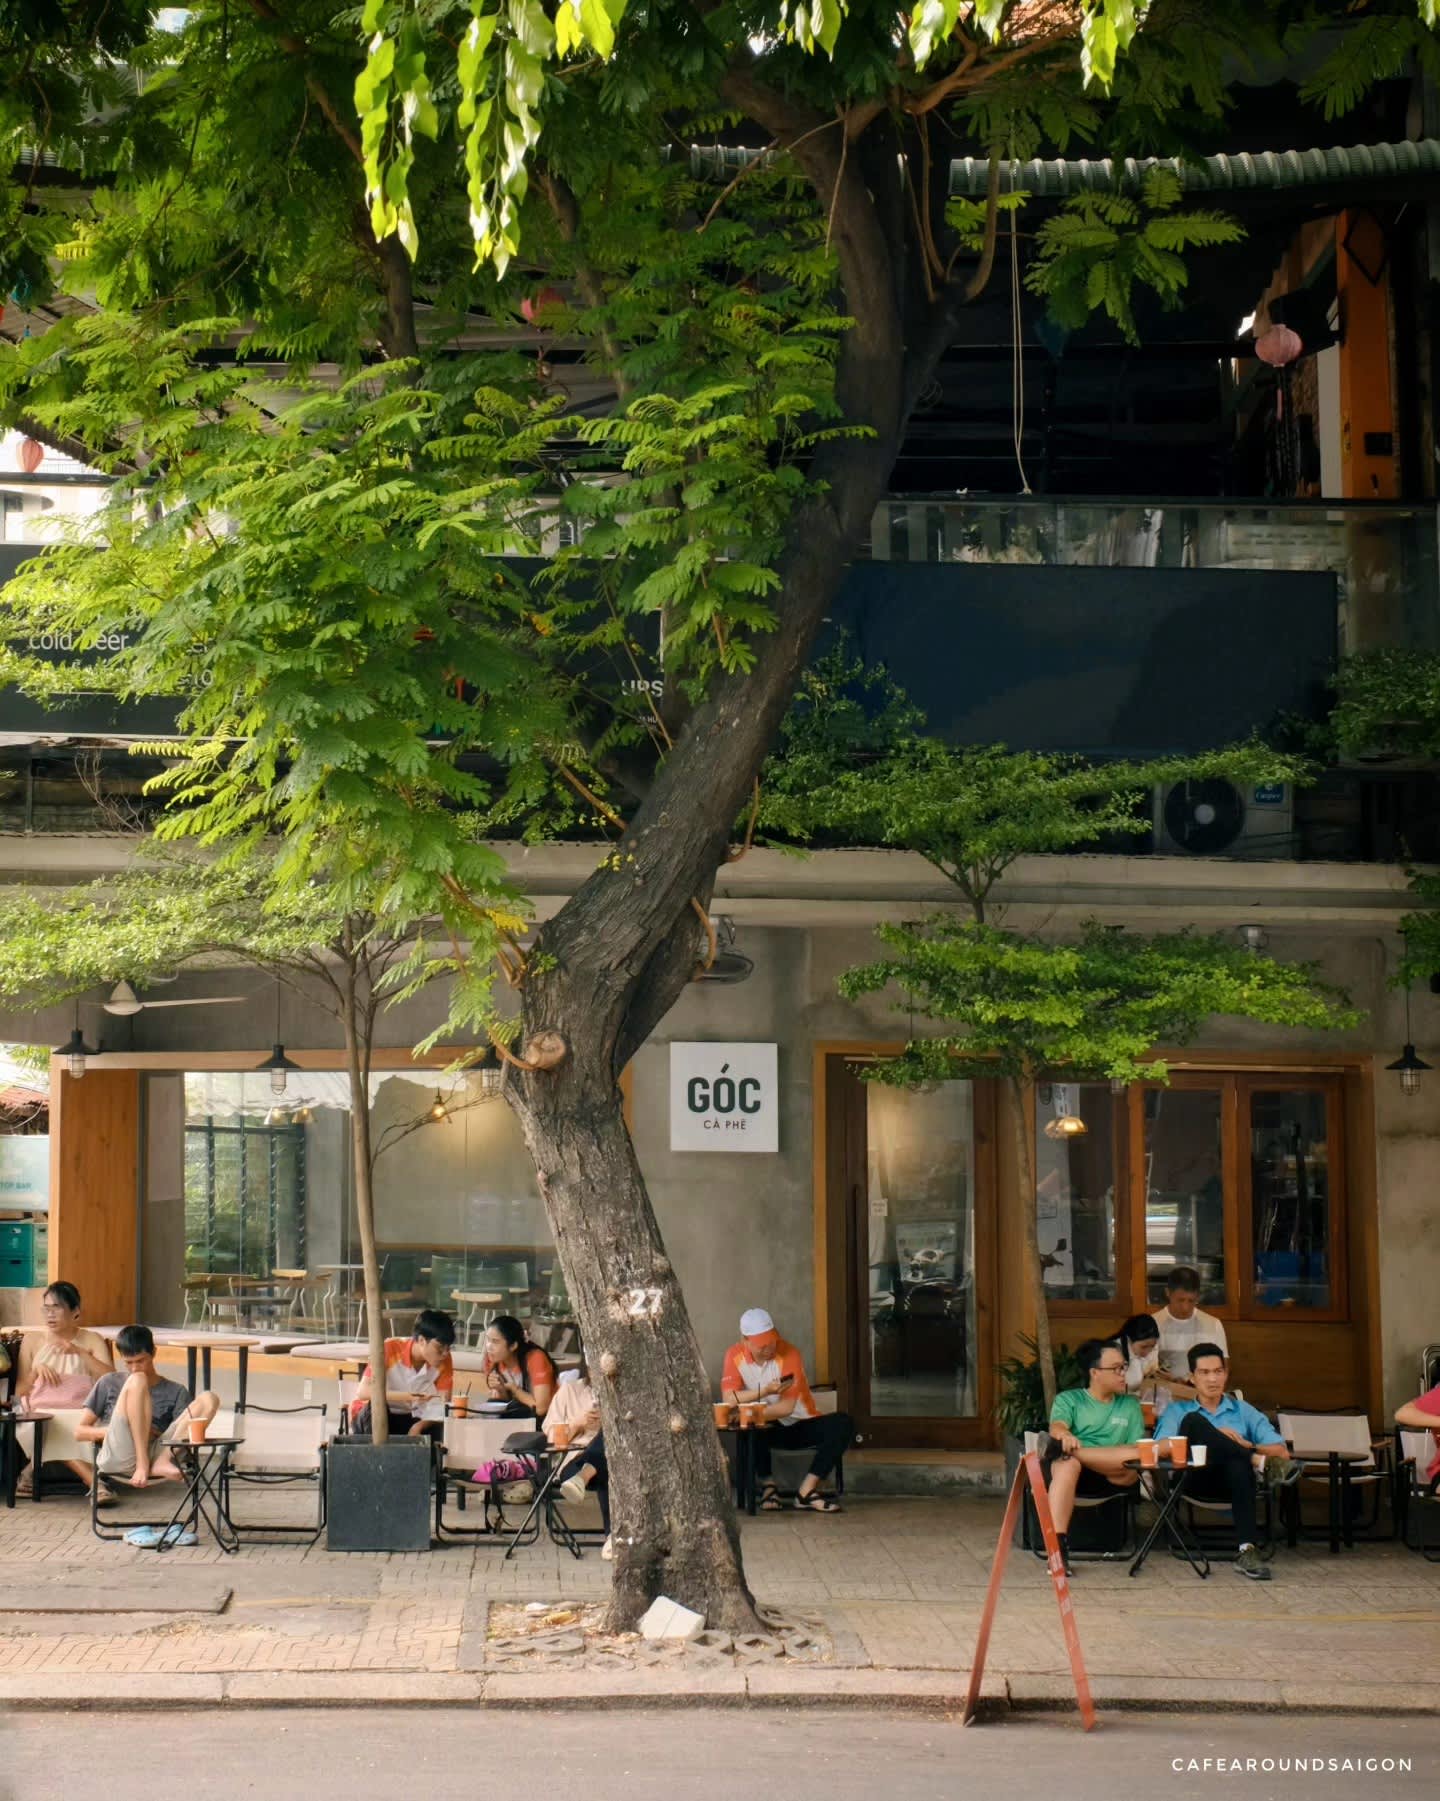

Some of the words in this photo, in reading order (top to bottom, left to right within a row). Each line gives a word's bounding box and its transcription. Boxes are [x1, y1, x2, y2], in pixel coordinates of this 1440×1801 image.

[82, 632, 130, 651] eer
[687, 1063, 761, 1114] GÓC
[703, 1117, 720, 1130] CÀ
[725, 1117, 747, 1130] PHÊ
[628, 1288, 663, 1315] 27
